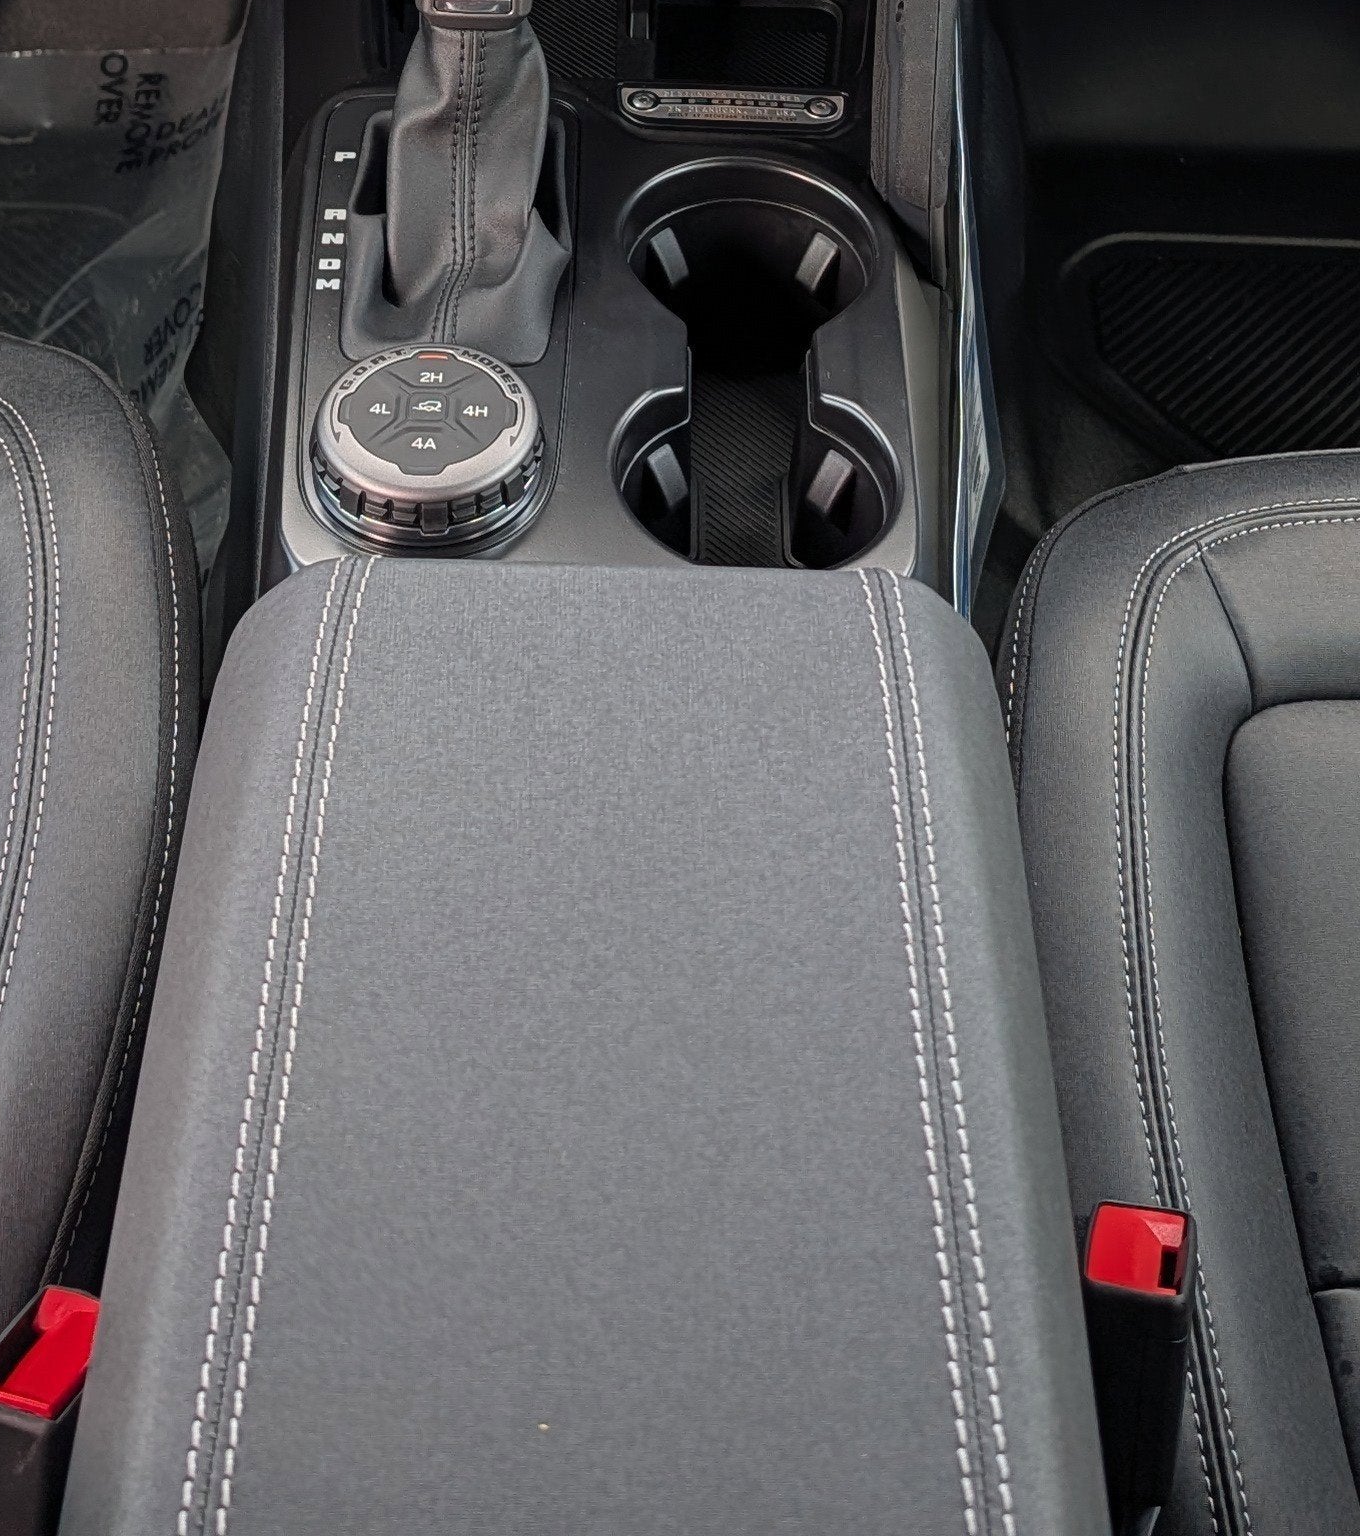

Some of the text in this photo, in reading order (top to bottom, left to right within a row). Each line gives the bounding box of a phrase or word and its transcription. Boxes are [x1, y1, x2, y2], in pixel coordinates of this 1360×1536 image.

[334, 151, 357, 162] P
[321, 232, 345, 244] N
[315, 278, 341, 290] M
[420, 372, 444, 383] 2H
[461, 350, 522, 395] MODES
[369, 403, 391, 415] 4L
[462, 405, 488, 418] 4H
[410, 437, 437, 450] 4A
